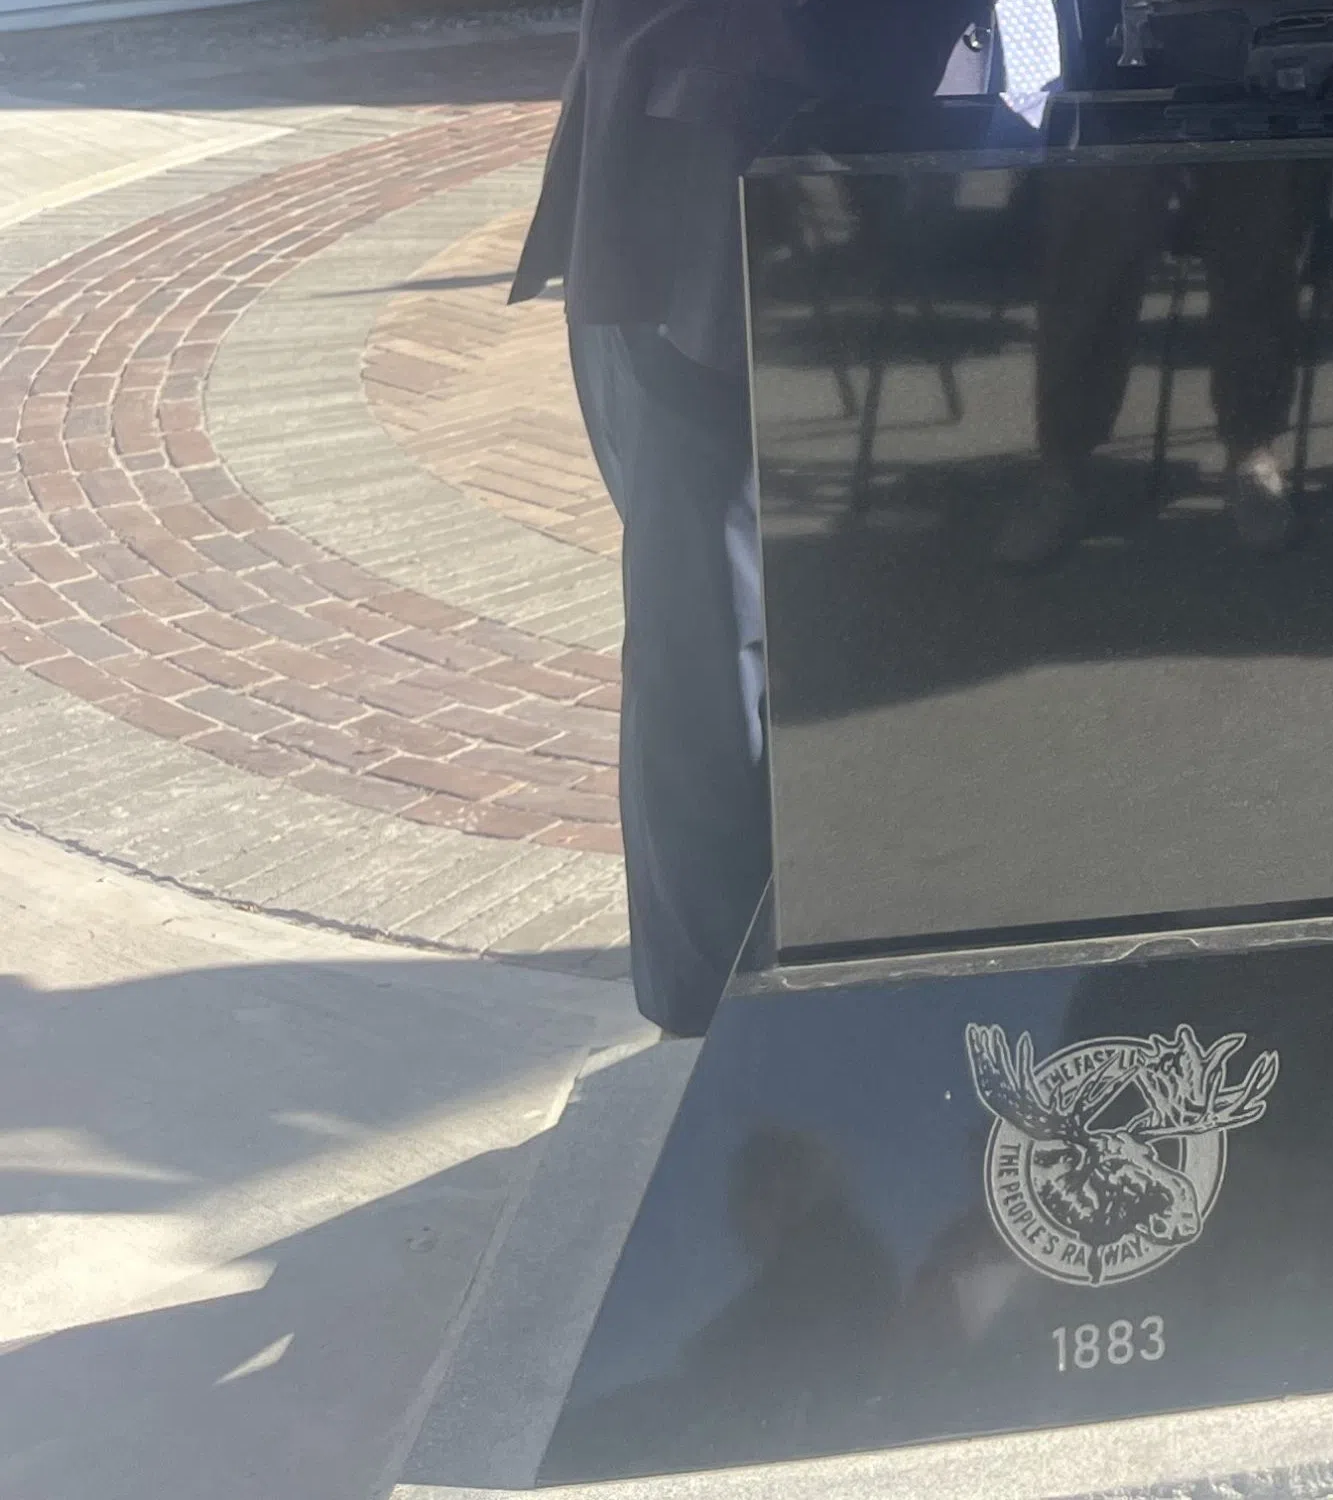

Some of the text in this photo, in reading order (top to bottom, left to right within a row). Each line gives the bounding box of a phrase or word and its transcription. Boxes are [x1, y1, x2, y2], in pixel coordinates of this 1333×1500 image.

[1040, 1063, 1074, 1091] THE
[998, 1143, 1022, 1178] THE
[1052, 1315, 1166, 1372] 1883
